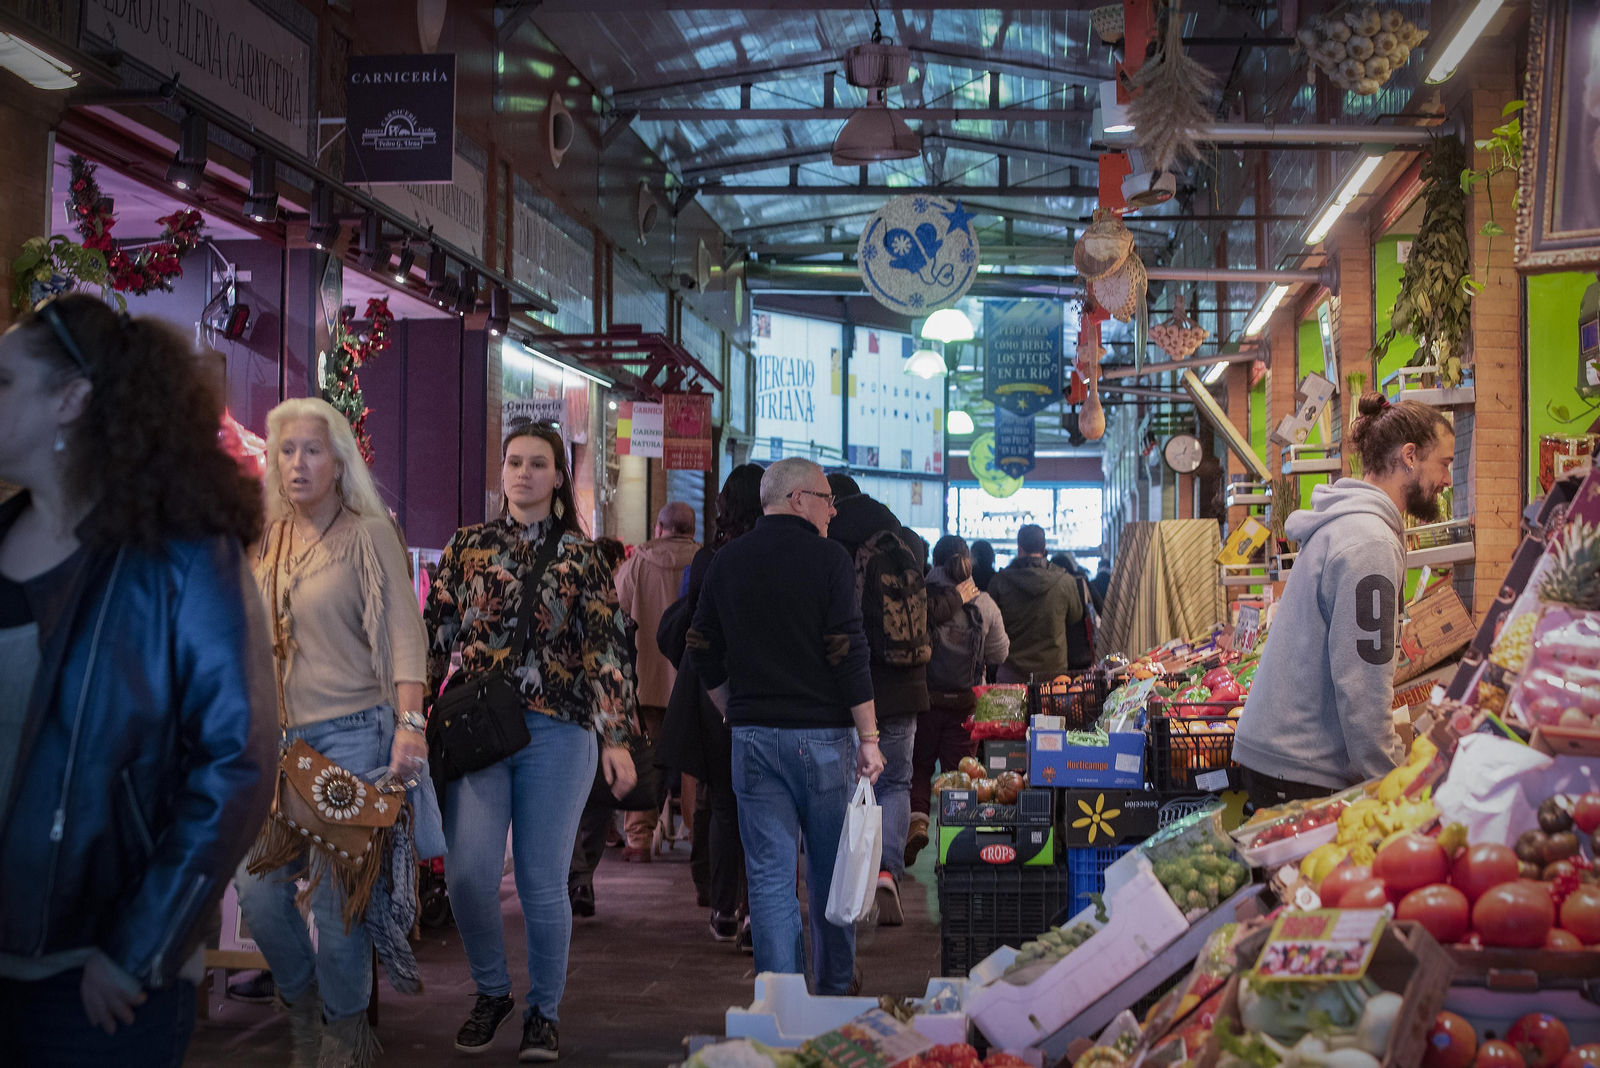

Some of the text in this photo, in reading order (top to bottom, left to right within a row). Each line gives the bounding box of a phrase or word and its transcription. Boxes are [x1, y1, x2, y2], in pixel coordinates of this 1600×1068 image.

[176, 0, 223, 80] ELENA
[226, 31, 302, 129] CARNICERÍA
[351, 68, 448, 84] CARNICERÍA
[1000, 326, 1048, 336] PERO MIRA
[1022, 340, 1053, 351] BEBEN
[997, 352, 1051, 365] LOS PECES
[998, 366, 1050, 379] EN EL RÍO
[758, 389, 815, 423] TRIANA
[1356, 574, 1396, 665] 9
[1066, 760, 1109, 772] Horticampo
[1124, 800, 1159, 809] Selección
[982, 846, 1015, 860] TROPS
